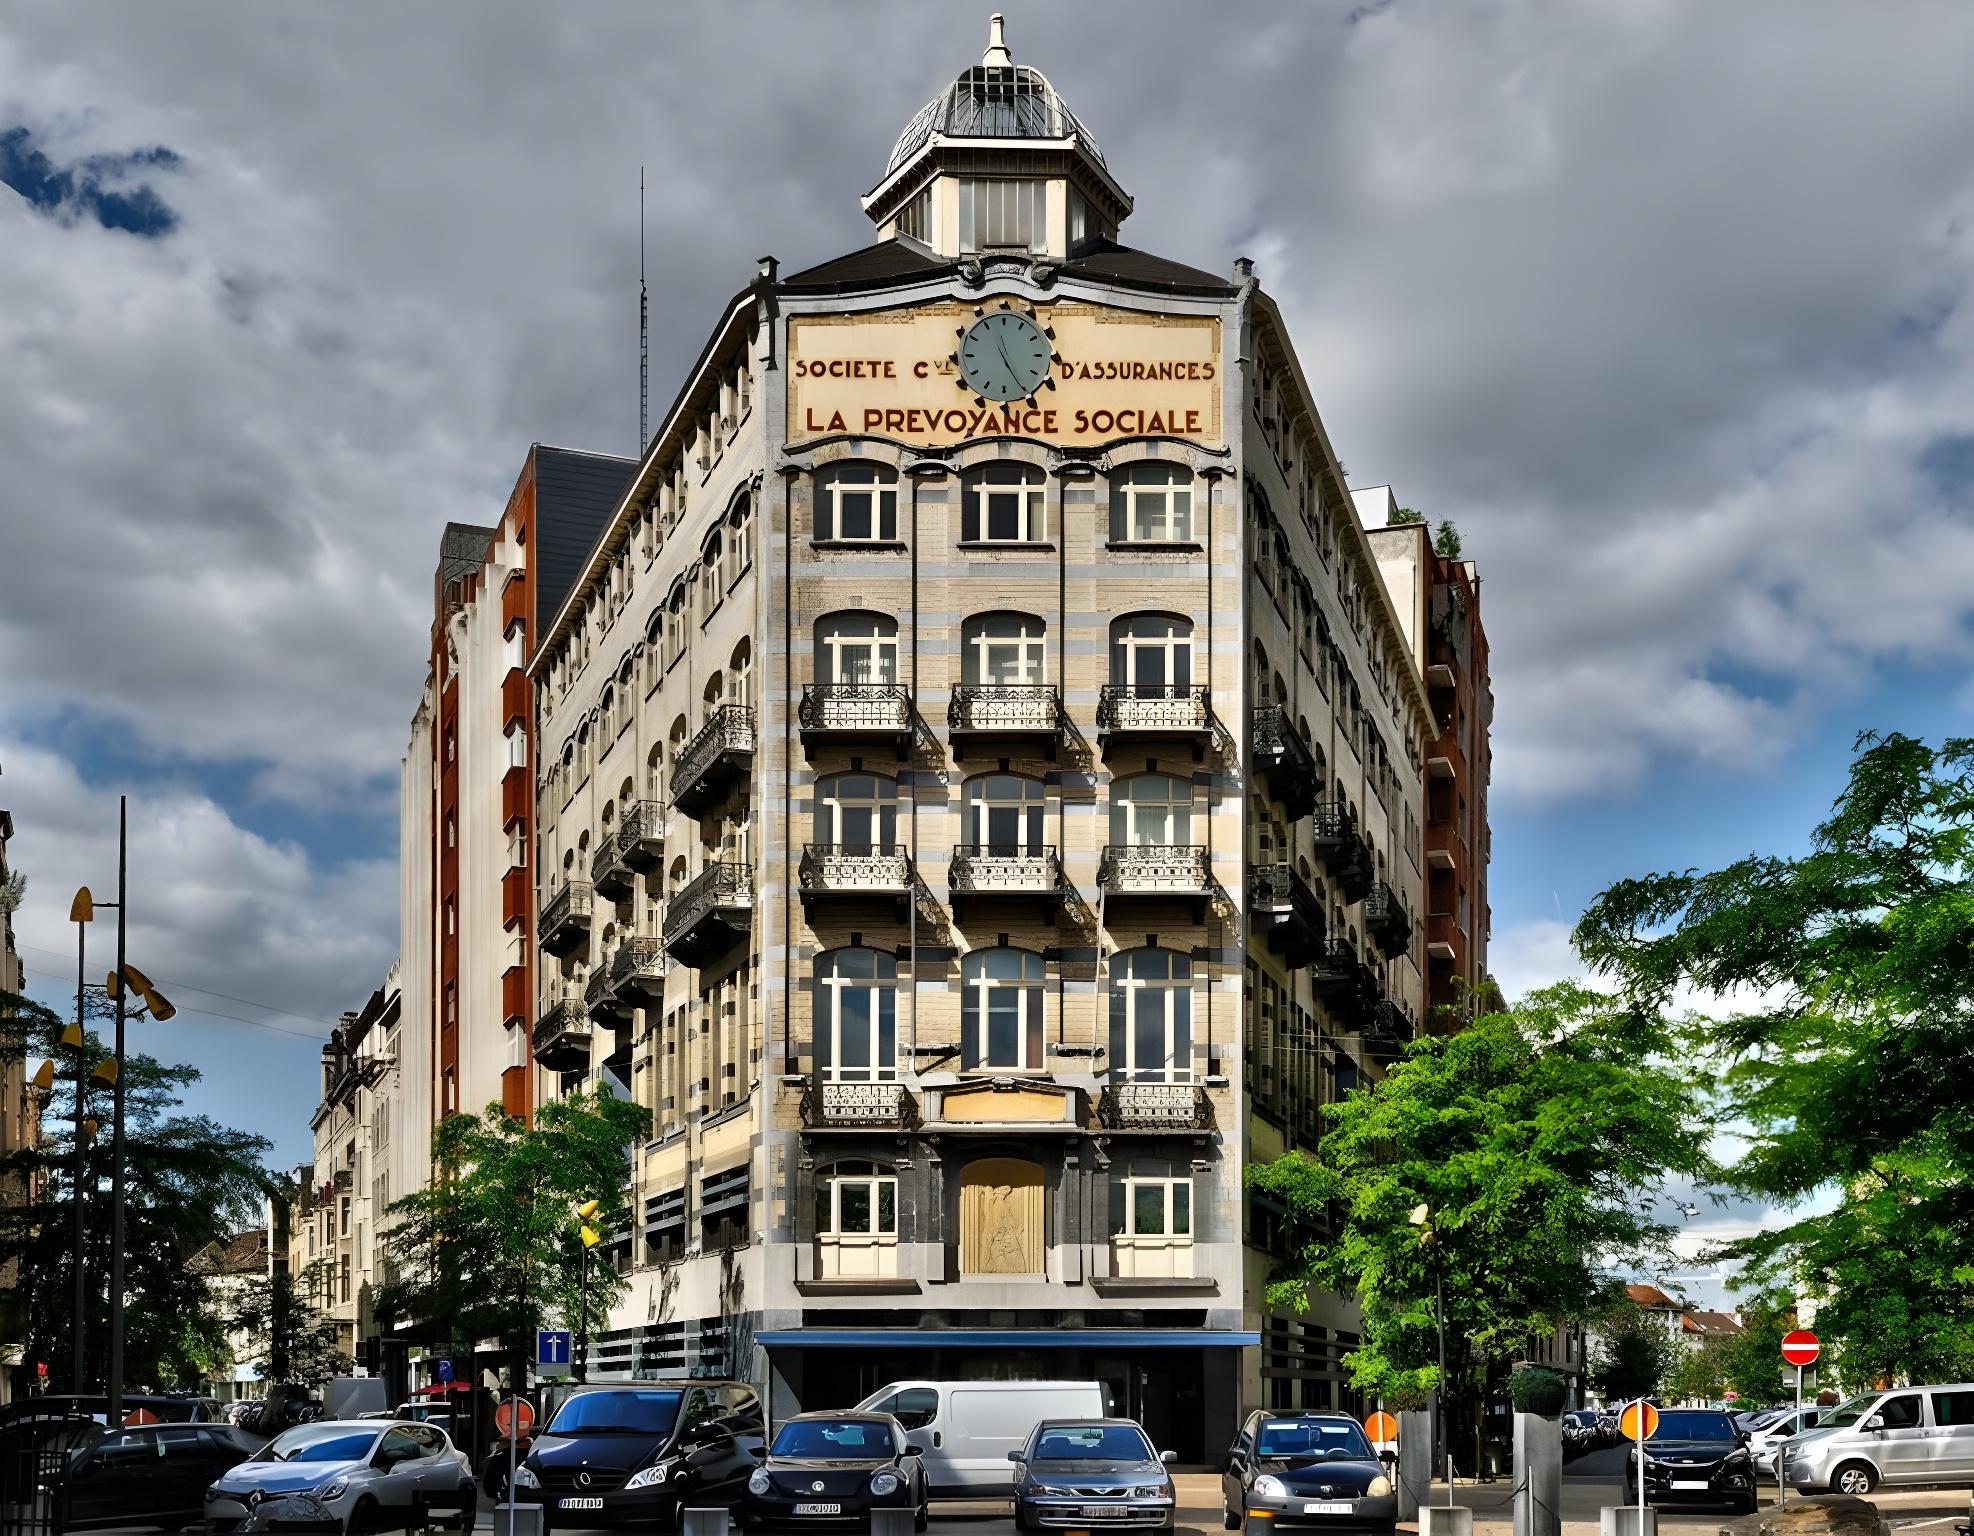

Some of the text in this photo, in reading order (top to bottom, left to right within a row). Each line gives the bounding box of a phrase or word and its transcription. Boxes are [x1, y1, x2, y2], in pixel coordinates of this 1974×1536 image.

[795, 360, 896, 378] SOCIETE
[1061, 361, 1215, 380] D'ASSURANCES
[806, 407, 1202, 434] LA PREVOYANCE SOCIALE
